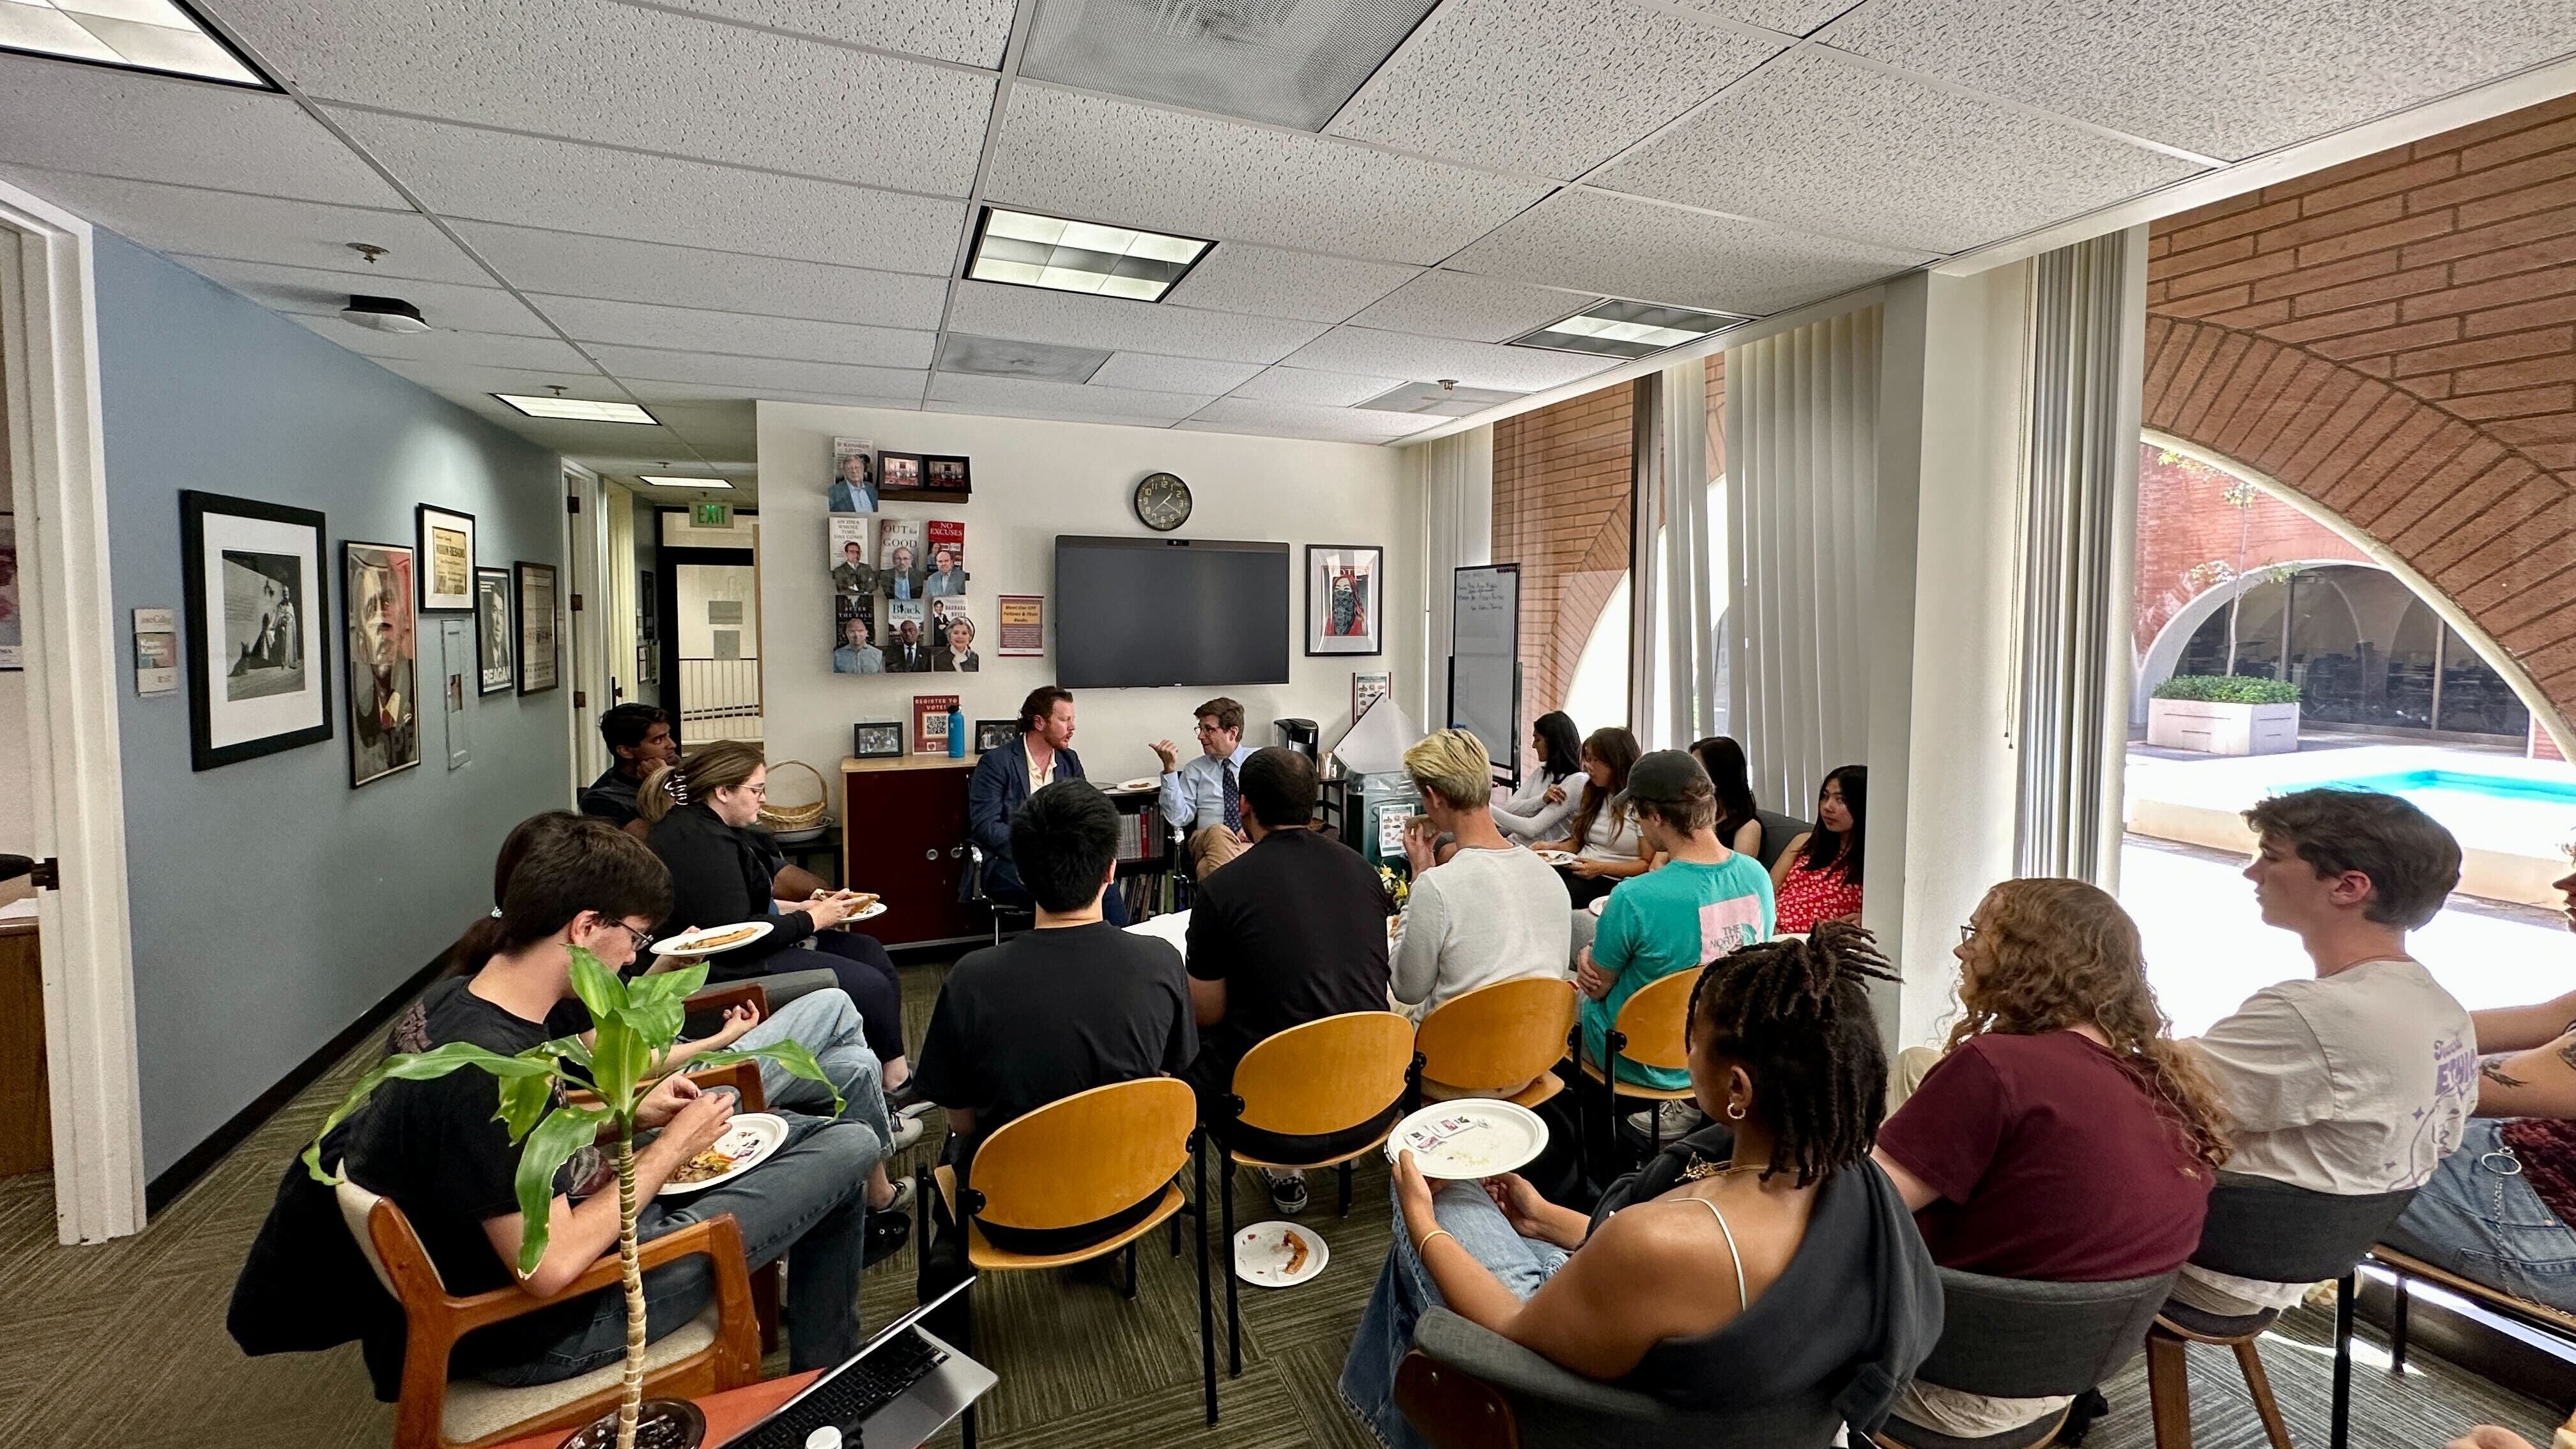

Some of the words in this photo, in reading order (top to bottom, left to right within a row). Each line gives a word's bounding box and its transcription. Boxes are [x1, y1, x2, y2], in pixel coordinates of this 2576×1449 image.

[697, 505, 726, 524] EXIT
[884, 525, 908, 534] OUT
[930, 528, 963, 536] EXCUSES
[883, 539, 917, 548] GOOD
[483, 666, 511, 686] REAGAN
[1722, 924, 1741, 936] THE
[1710, 933, 1742, 947] NORTH
